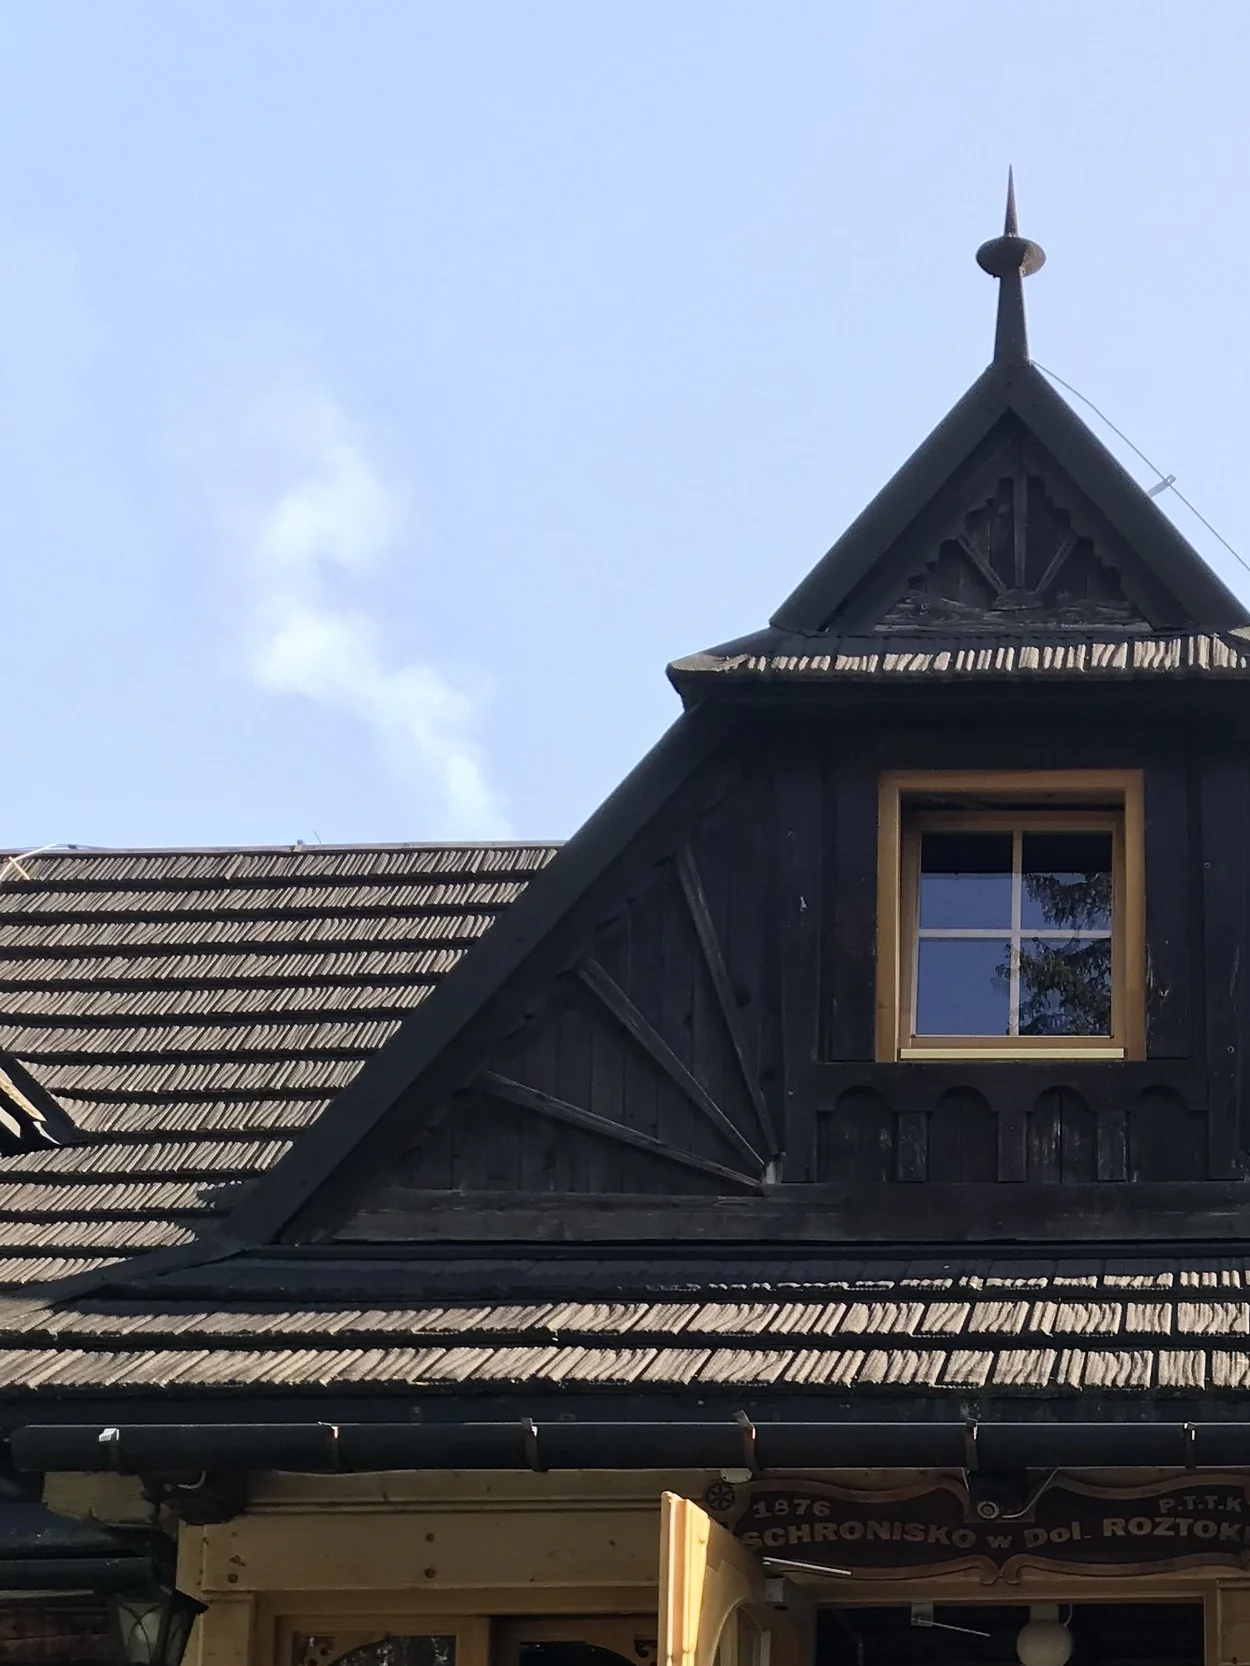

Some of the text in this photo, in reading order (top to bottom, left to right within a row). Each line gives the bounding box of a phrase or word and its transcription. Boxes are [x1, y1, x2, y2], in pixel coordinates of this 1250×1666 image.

[752, 1499, 832, 1519] 1876
[742, 1520, 976, 1549] SCHRONISKO
[986, 1535, 1013, 1549] w
